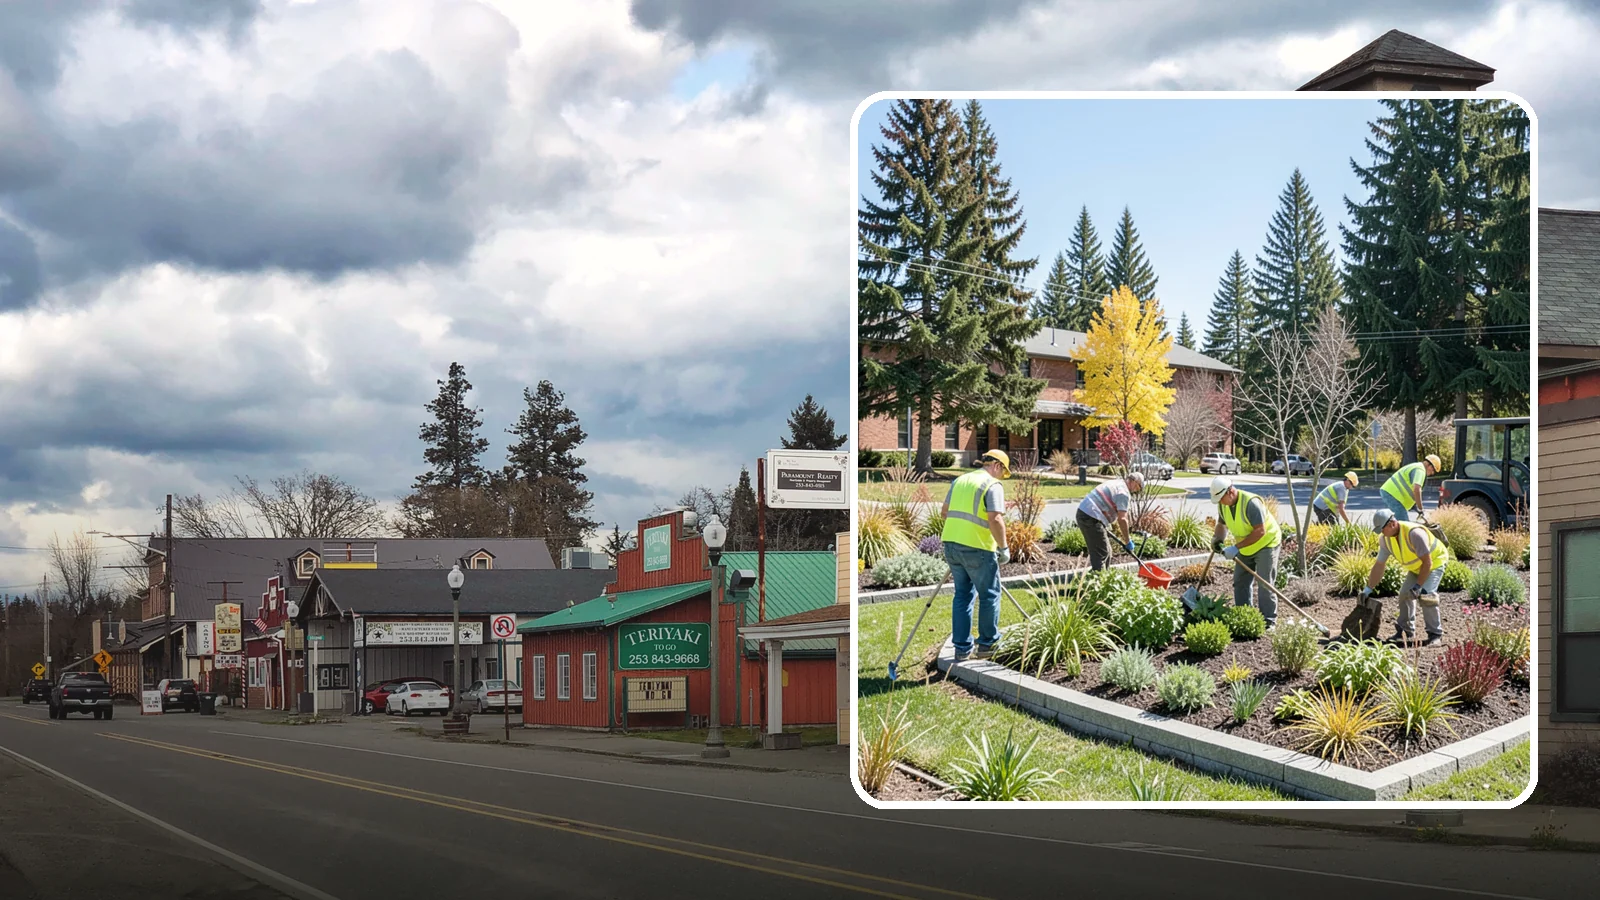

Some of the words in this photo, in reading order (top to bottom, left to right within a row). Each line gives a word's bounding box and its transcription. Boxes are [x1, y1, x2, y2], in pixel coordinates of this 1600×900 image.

[625, 628, 702, 646] TERIYAKI
[629, 654, 648, 664] 253
[652, 654, 700, 664] 843-9668
